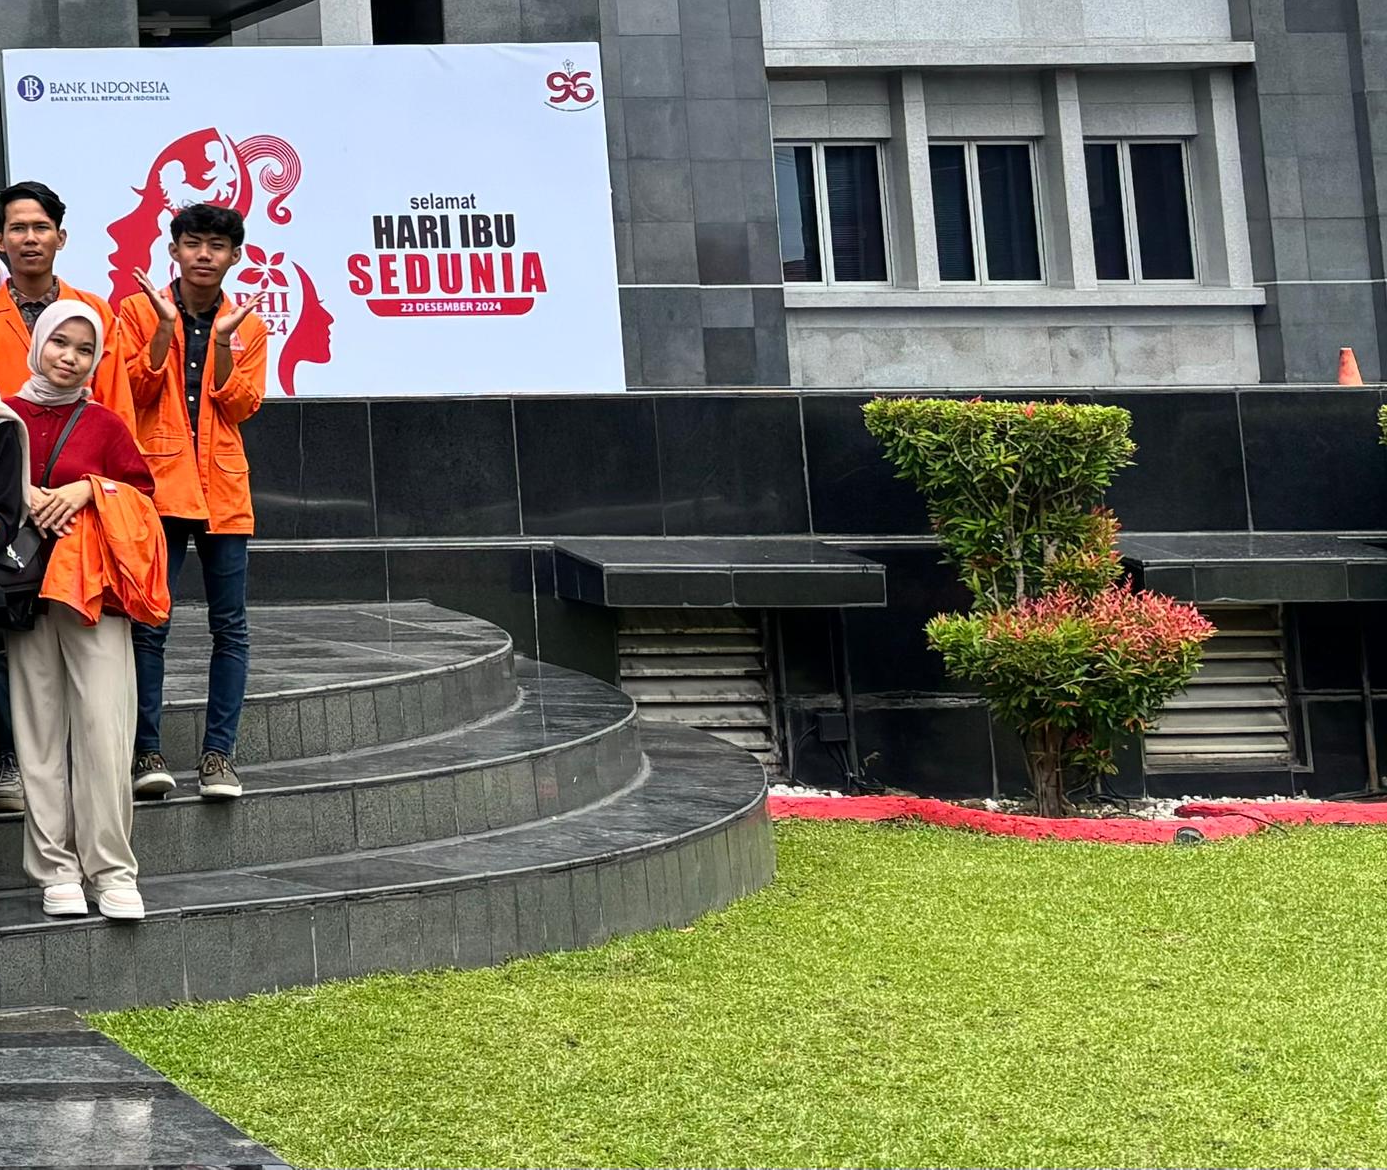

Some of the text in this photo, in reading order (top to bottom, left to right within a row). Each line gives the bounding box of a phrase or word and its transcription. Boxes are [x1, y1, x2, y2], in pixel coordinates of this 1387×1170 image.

[49, 81, 170, 94] BANK INDONESIA
[546, 71, 595, 103] 96
[410, 193, 477, 210] selamat
[372, 214, 516, 249] HARI IBU
[347, 252, 547, 296] SEDUNIA
[400, 301, 502, 312] 22 DESEMBER 2024
